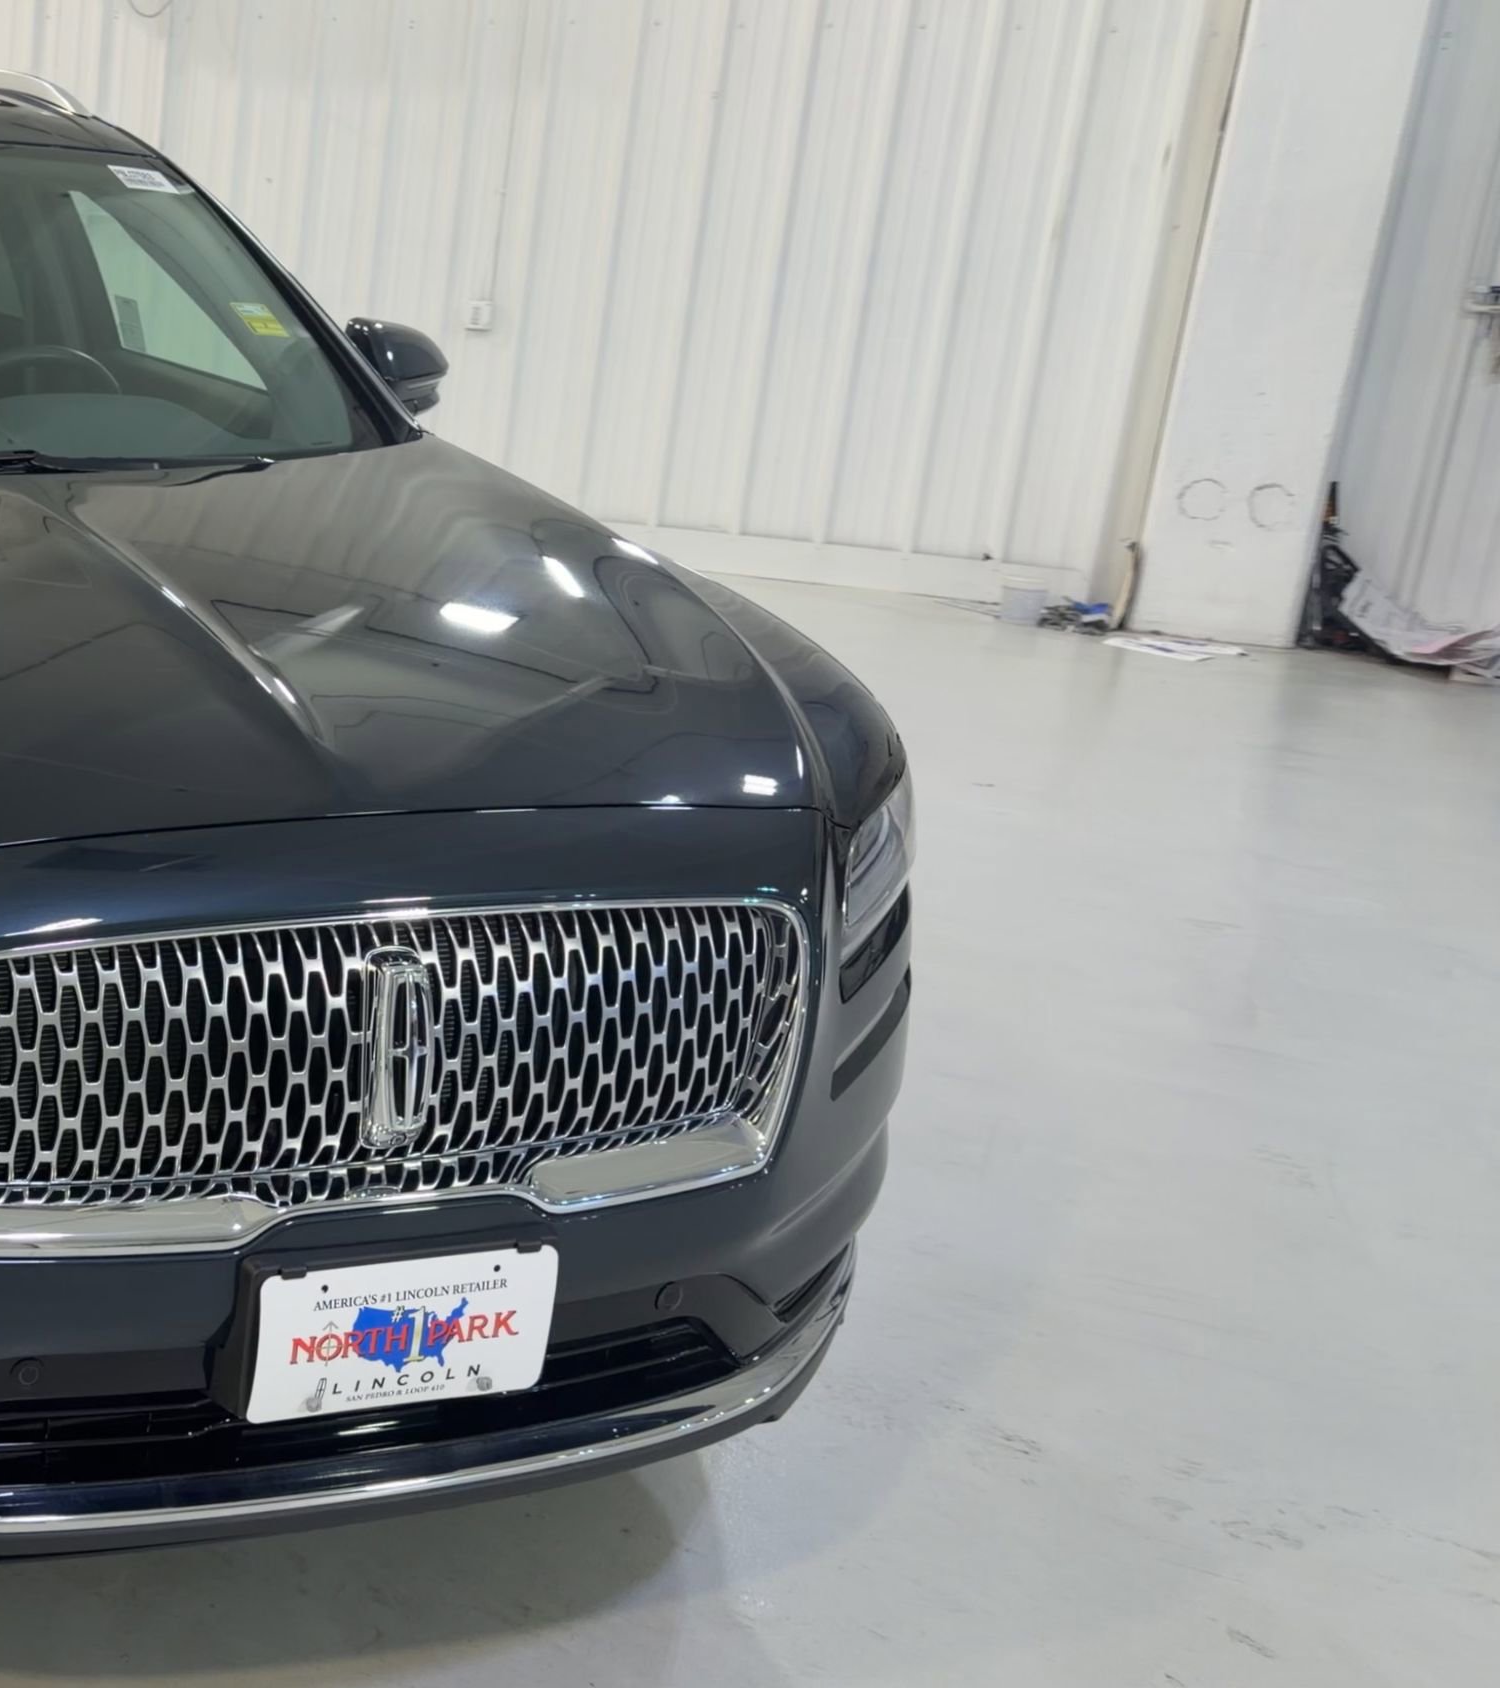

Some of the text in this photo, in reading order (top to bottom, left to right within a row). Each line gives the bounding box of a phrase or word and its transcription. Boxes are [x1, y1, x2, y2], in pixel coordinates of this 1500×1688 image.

[313, 1278, 508, 1312] AMERICA'S #1 LINCOLN RETAILER
[289, 1310, 519, 1366] NORTH PARK
[332, 1364, 481, 1395] LINCOLN
[346, 1394, 363, 1402] SAN
[365, 1389, 395, 1401] PEDRO
[405, 1385, 430, 1396] LOOP
